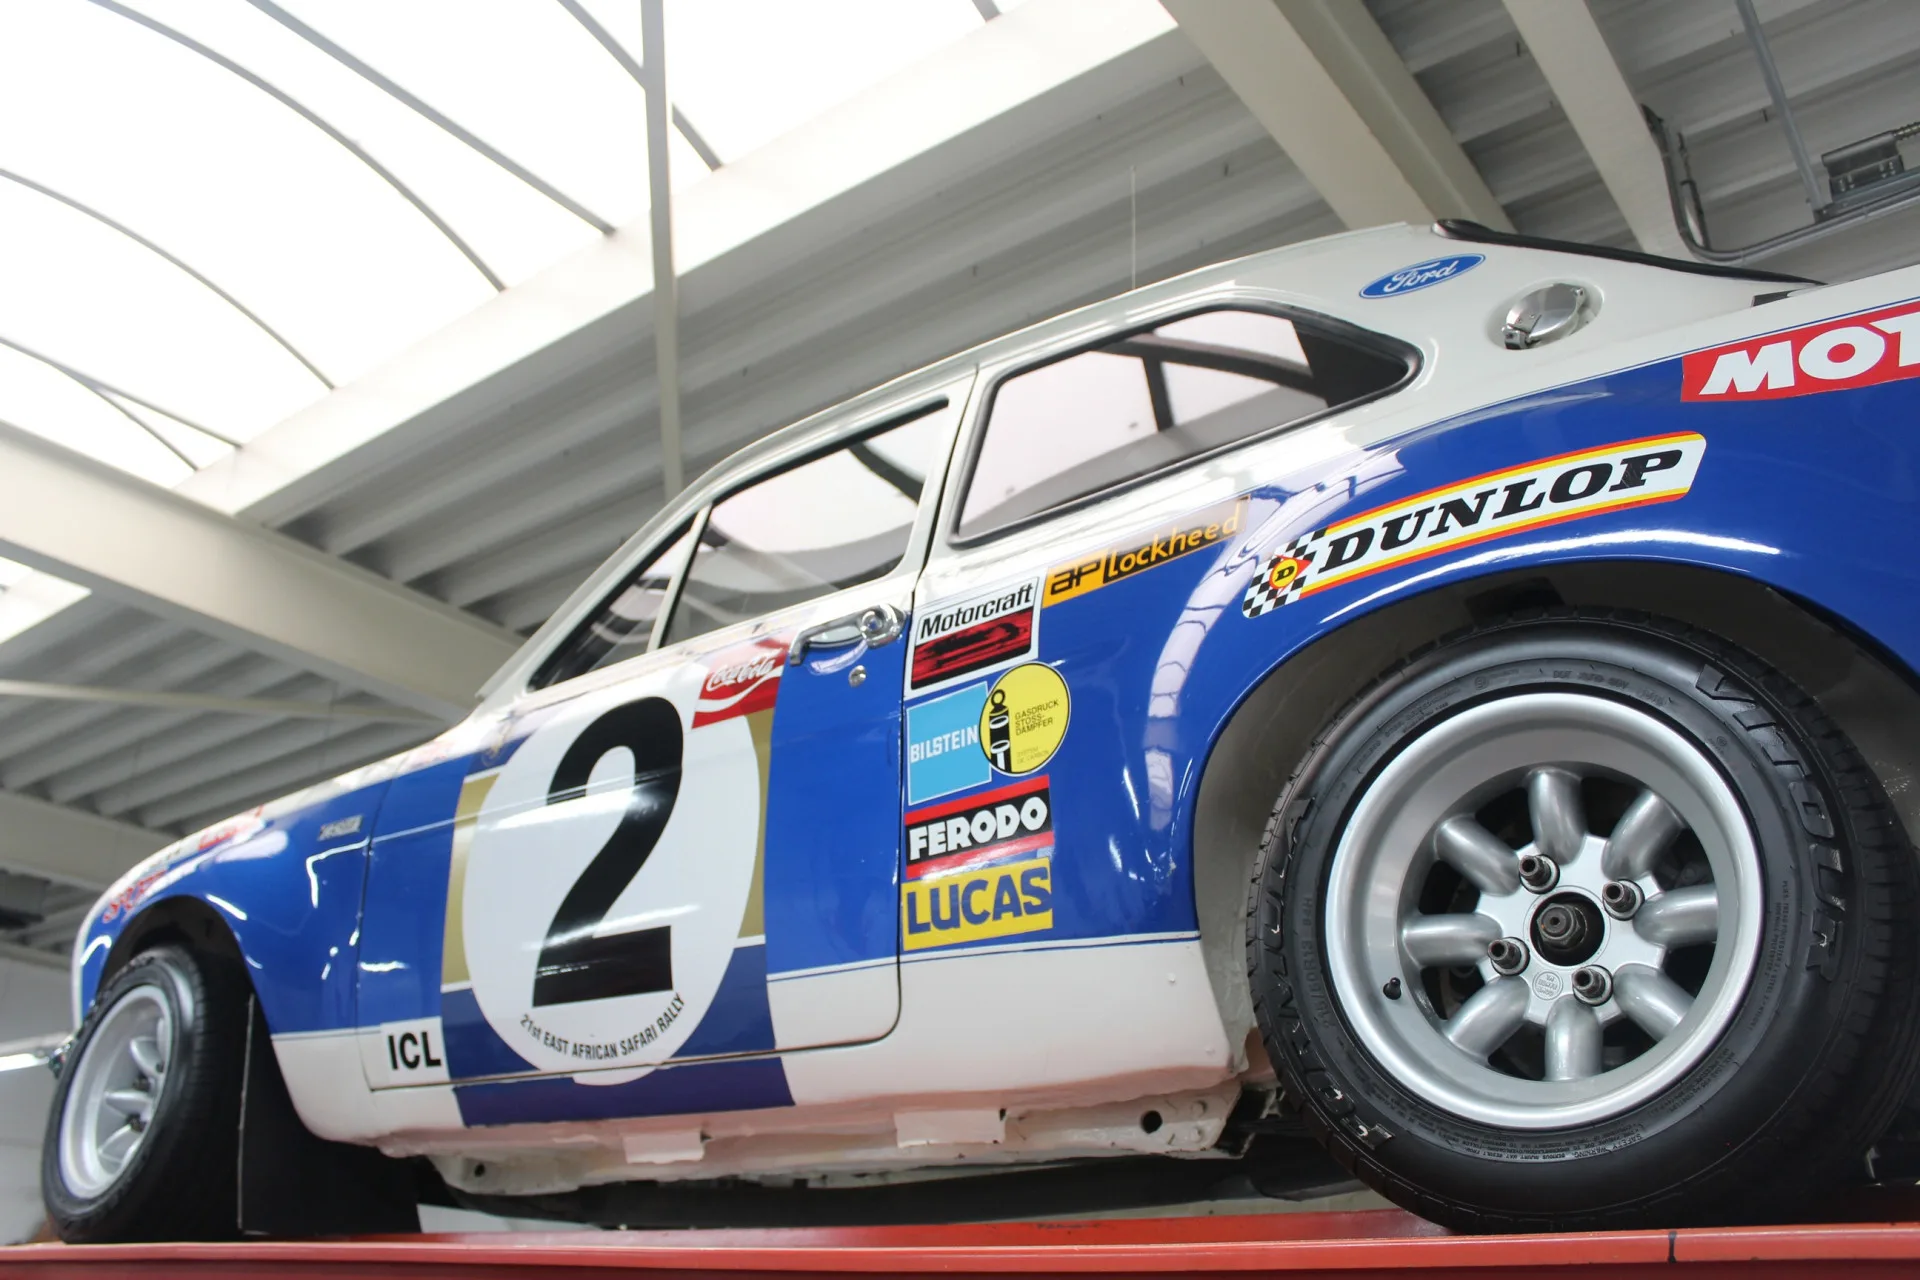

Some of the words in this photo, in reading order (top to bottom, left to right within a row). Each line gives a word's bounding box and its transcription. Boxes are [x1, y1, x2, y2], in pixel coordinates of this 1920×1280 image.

[1382, 260, 1459, 293] Ford
[1317, 449, 1684, 574] DUNLOP
[919, 581, 1033, 640] Motorcraft
[1014, 698, 1060, 721] GASDRUCK
[909, 731, 979, 764] BILSTEIN
[532, 696, 684, 1008] 2
[908, 796, 1049, 862] FERODO
[1694, 663, 1844, 982] VITOUR
[907, 866, 1053, 934] LUCAS
[387, 1031, 442, 1071] ICL
[519, 1013, 542, 1041] 21st
[543, 1031, 569, 1056] EAST
[571, 1040, 619, 1061] AFRICAN
[619, 1024, 659, 1057] SAFARI
[658, 993, 686, 1034] RALLY
